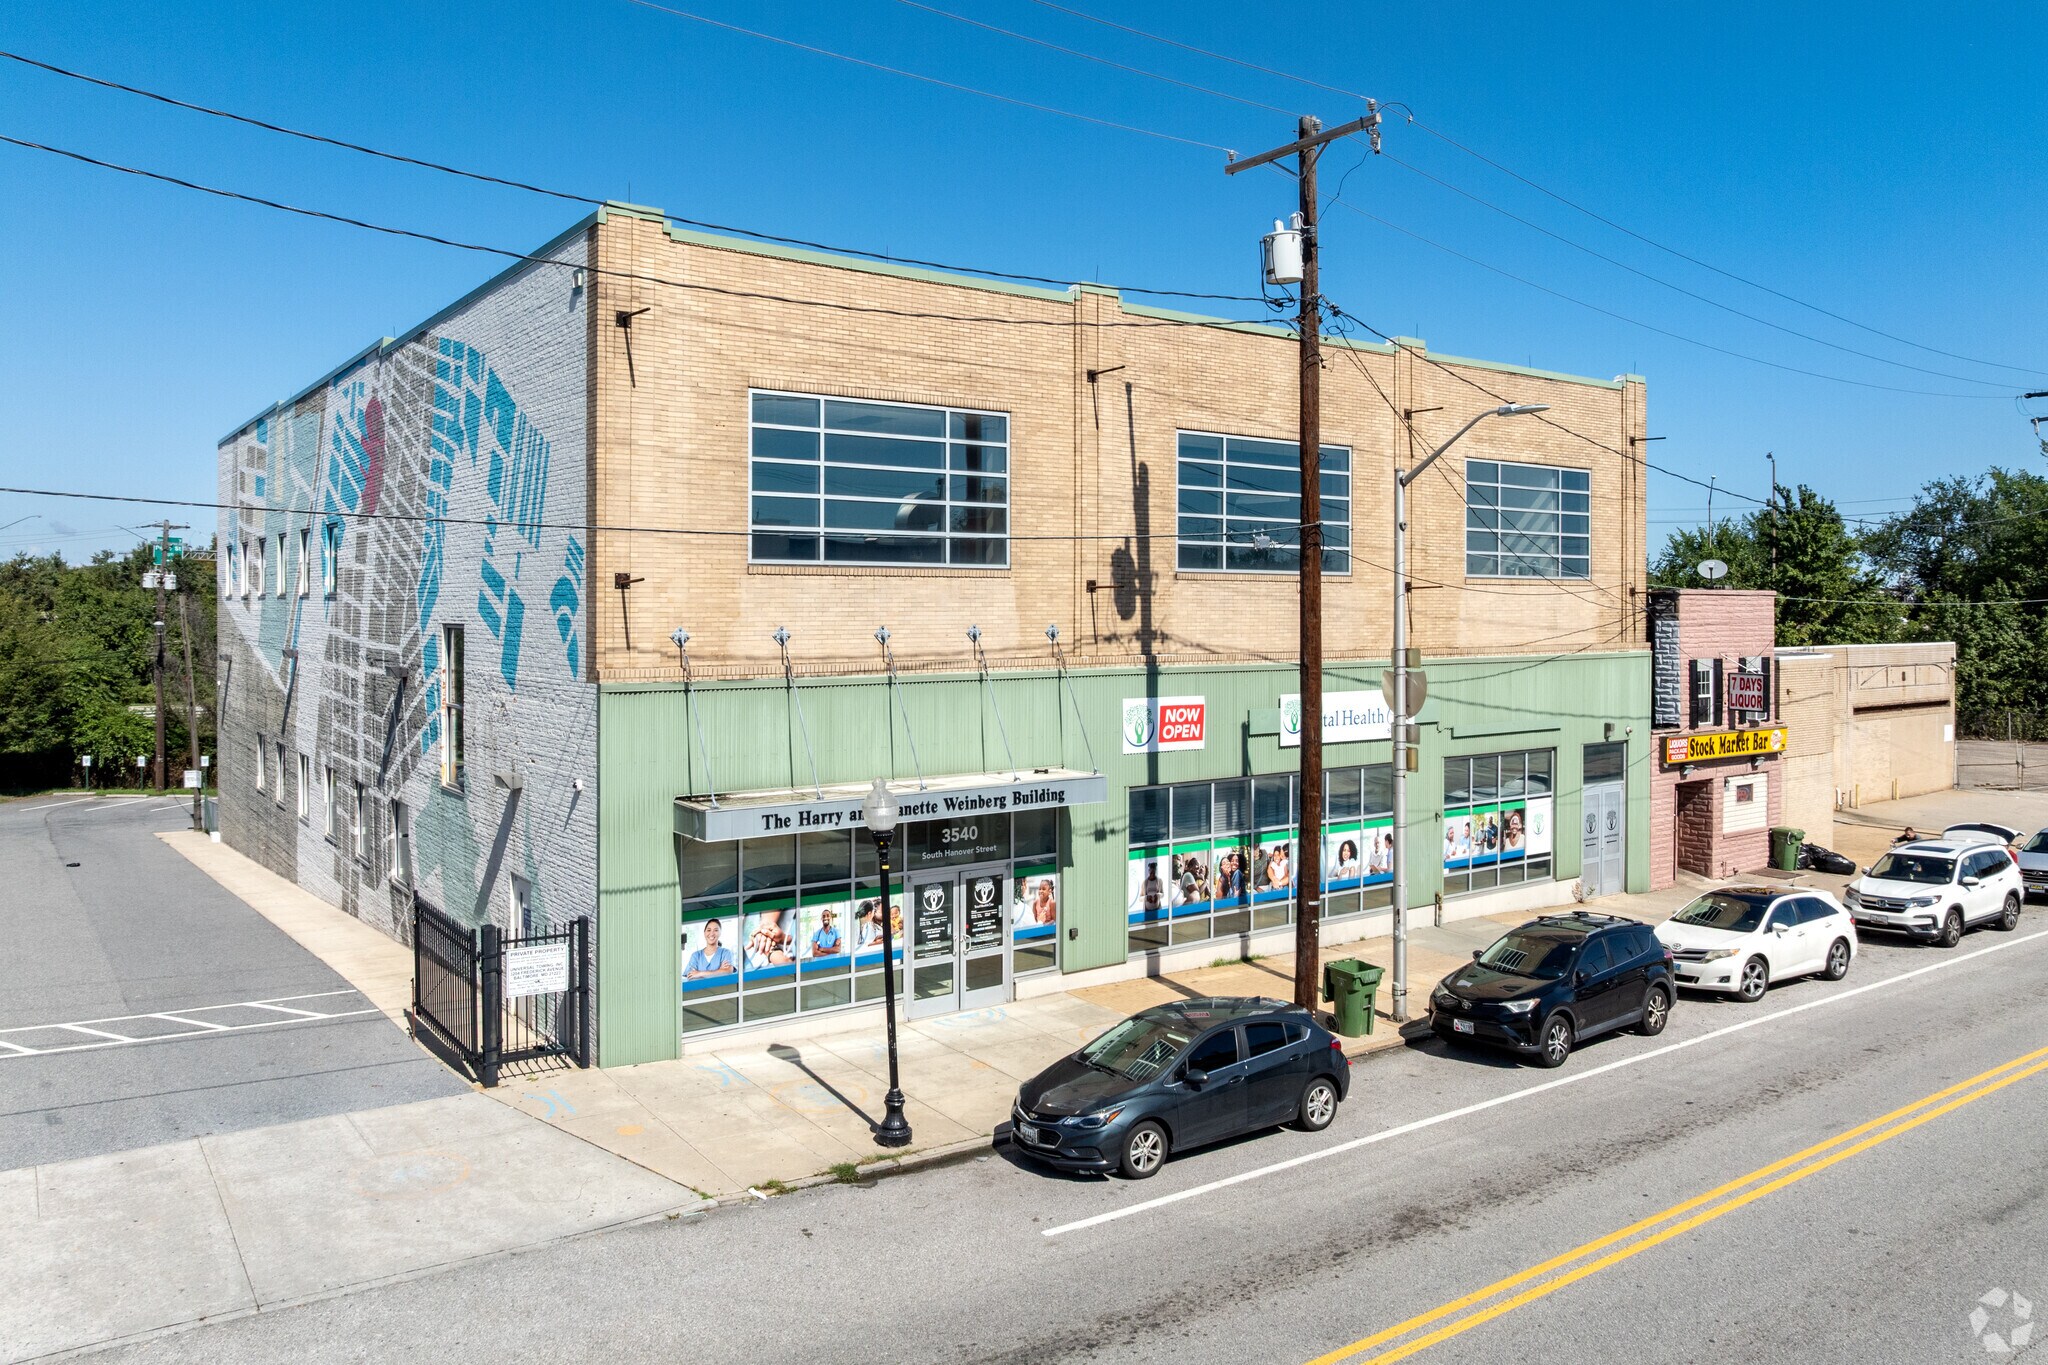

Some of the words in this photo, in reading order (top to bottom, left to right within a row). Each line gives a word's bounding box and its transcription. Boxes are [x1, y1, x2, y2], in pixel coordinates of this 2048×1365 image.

[1731, 676, 1737, 691] 7
[1739, 677, 1763, 692] DAYS
[1730, 693, 1763, 709] LIQUOR
[1165, 707, 1201, 723] NOW
[1322, 710, 1339, 728] tal
[1342, 708, 1384, 726] Health
[1162, 723, 1201, 740] OPEN
[1689, 738, 1715, 758] Stock
[1718, 735, 1750, 755] Market
[1752, 732, 1768, 751] Bar
[762, 813, 791, 831] The
[798, 810, 843, 827] Harry
[849, 808, 865, 822] an
[943, 794, 1006, 812] Weinberg
[1012, 788, 1065, 806] Building
[942, 825, 978, 844] 3540
[922, 850, 943, 860] South
[944, 847, 974, 857] Hanover
[975, 844, 997, 853] Street
